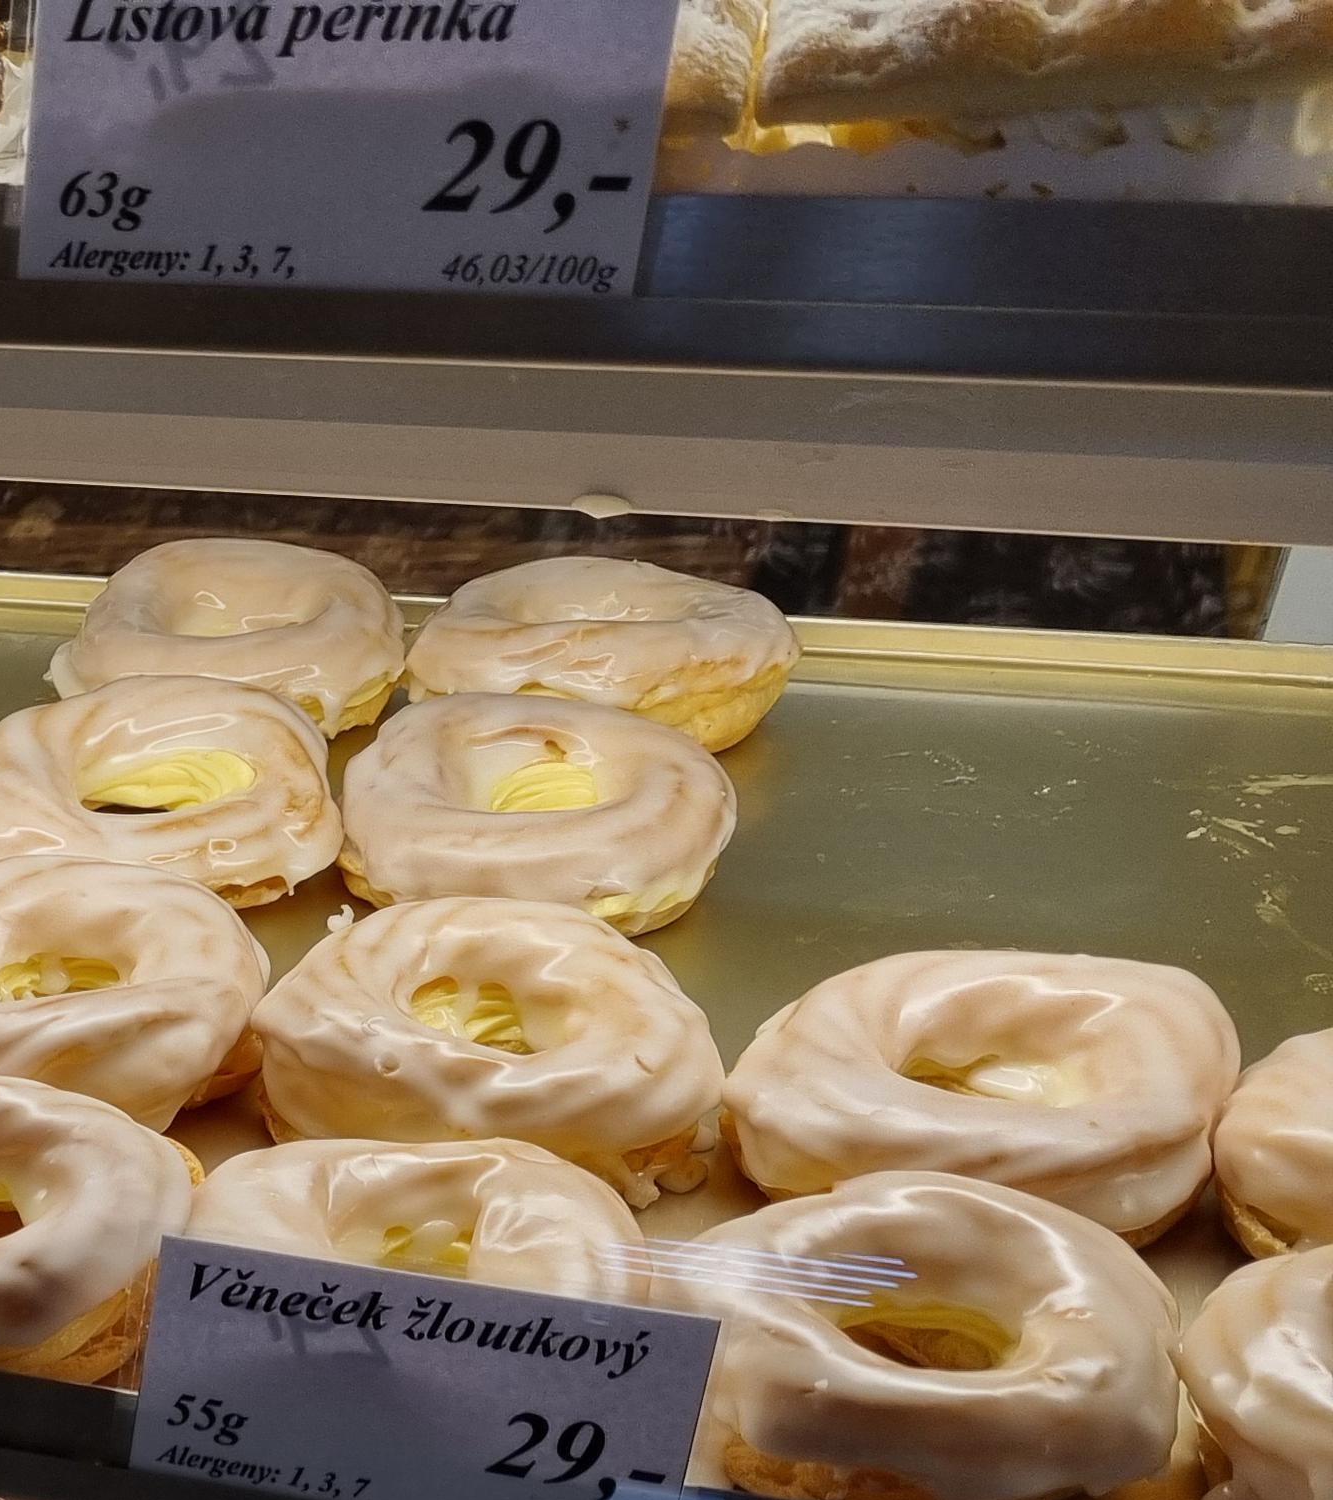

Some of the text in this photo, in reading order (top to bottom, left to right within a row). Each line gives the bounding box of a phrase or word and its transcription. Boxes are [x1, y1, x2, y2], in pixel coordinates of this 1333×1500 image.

[58, 171, 152, 231] 63g
[421, 117, 632, 234] 29,-
[49, 241, 296, 279] Alergeny: 1, 3, 7,
[440, 252, 618, 293] 46,03/100g
[189, 1261, 651, 1381] Věneček žloutkový
[166, 1393, 249, 1447] 55g
[156, 1443, 371, 1499] Alergeny: 1, 3, 7
